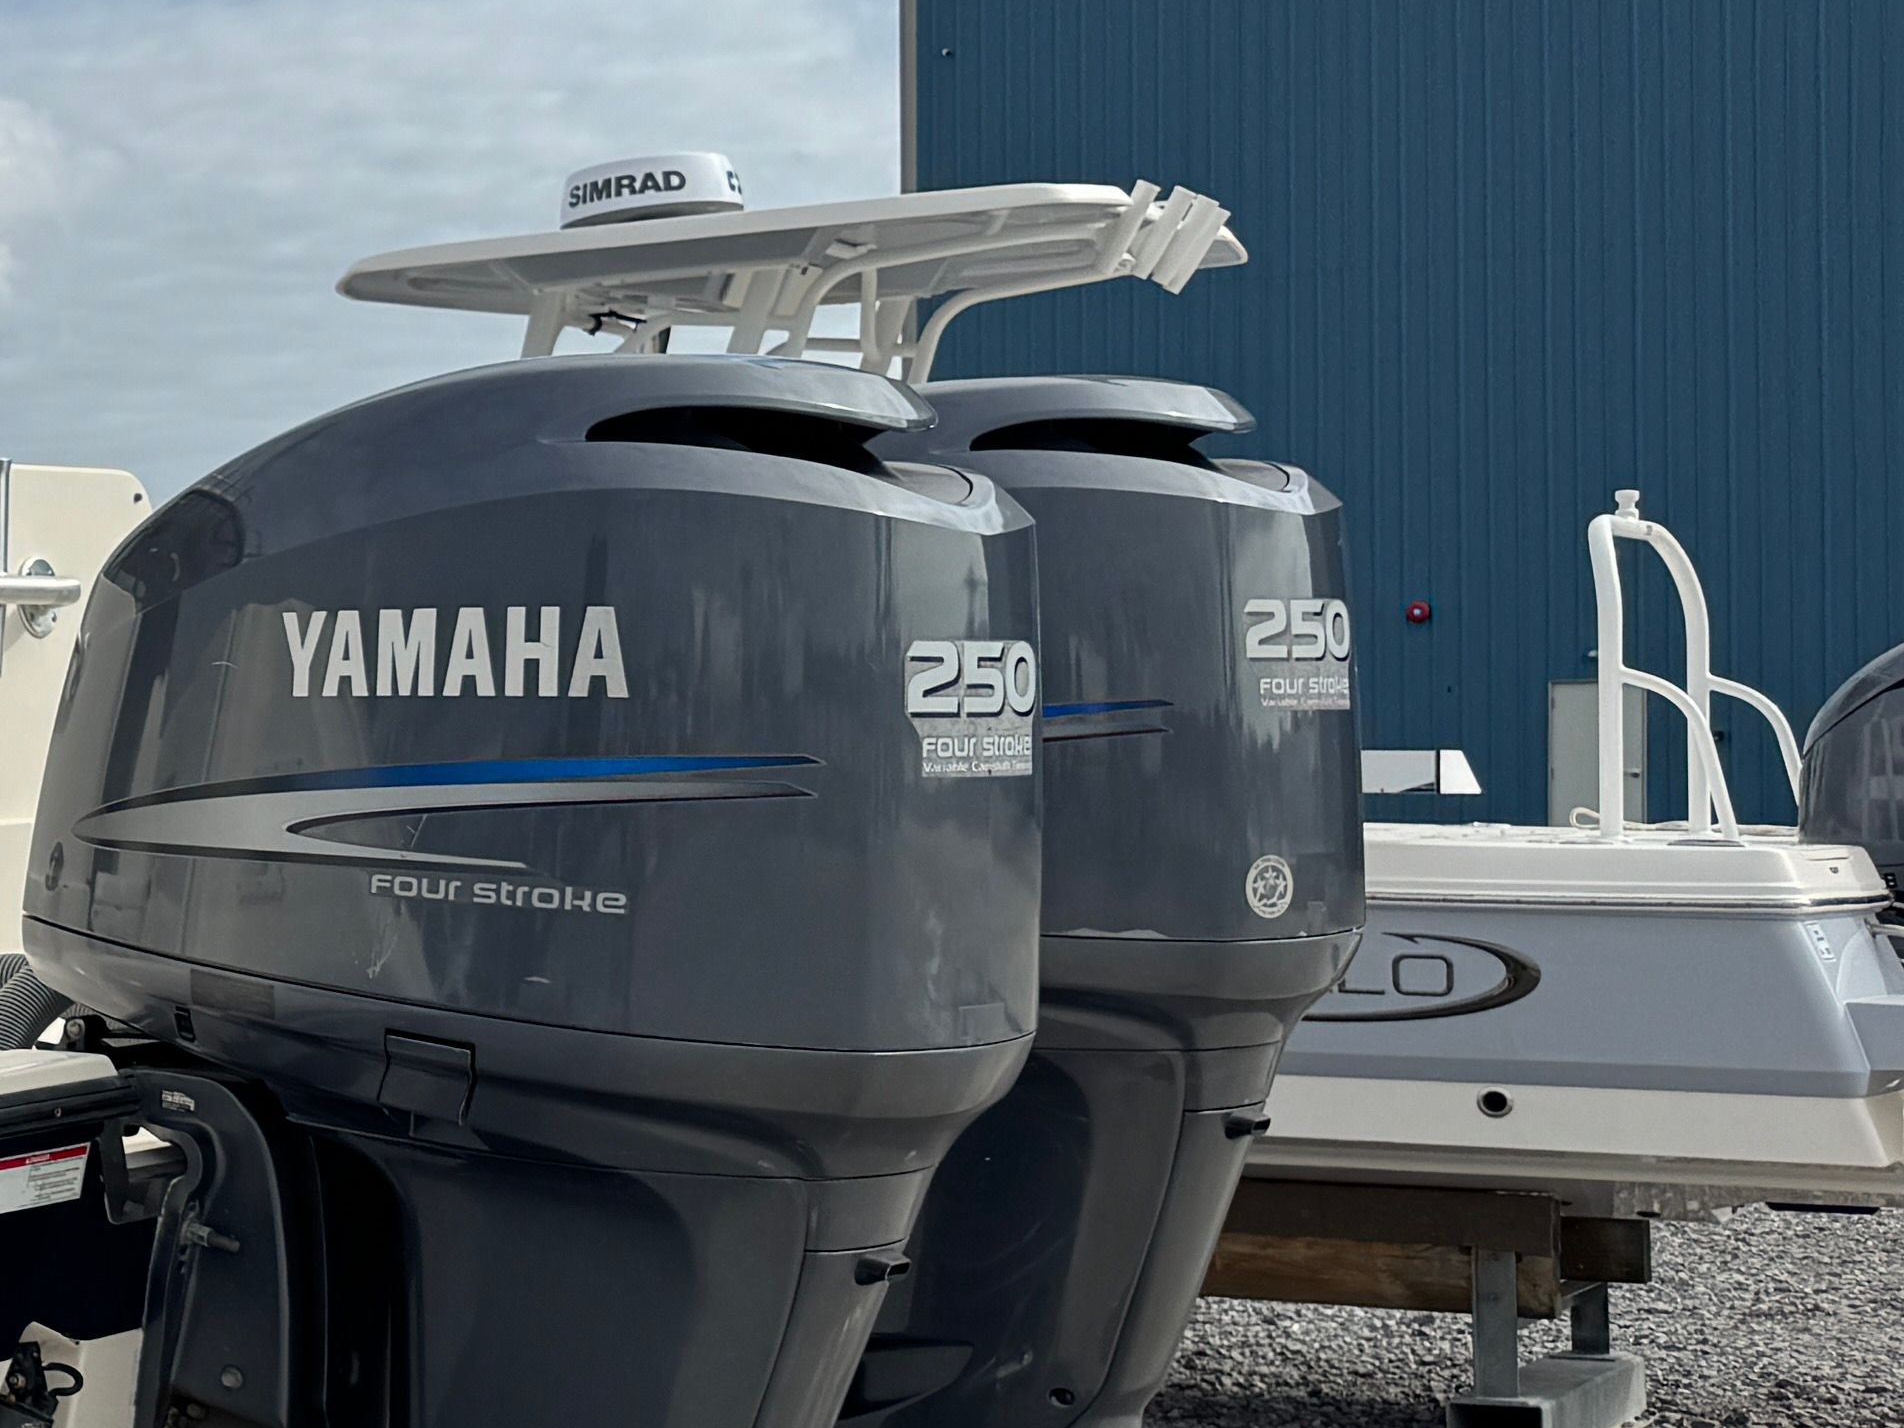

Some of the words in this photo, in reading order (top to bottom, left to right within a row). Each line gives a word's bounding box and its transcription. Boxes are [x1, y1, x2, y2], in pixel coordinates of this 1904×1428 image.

[568, 170, 686, 208] SIMRAD
[282, 605, 630, 699] YAMAHA
[1243, 599, 1350, 662] 250
[906, 640, 1037, 718] 250
